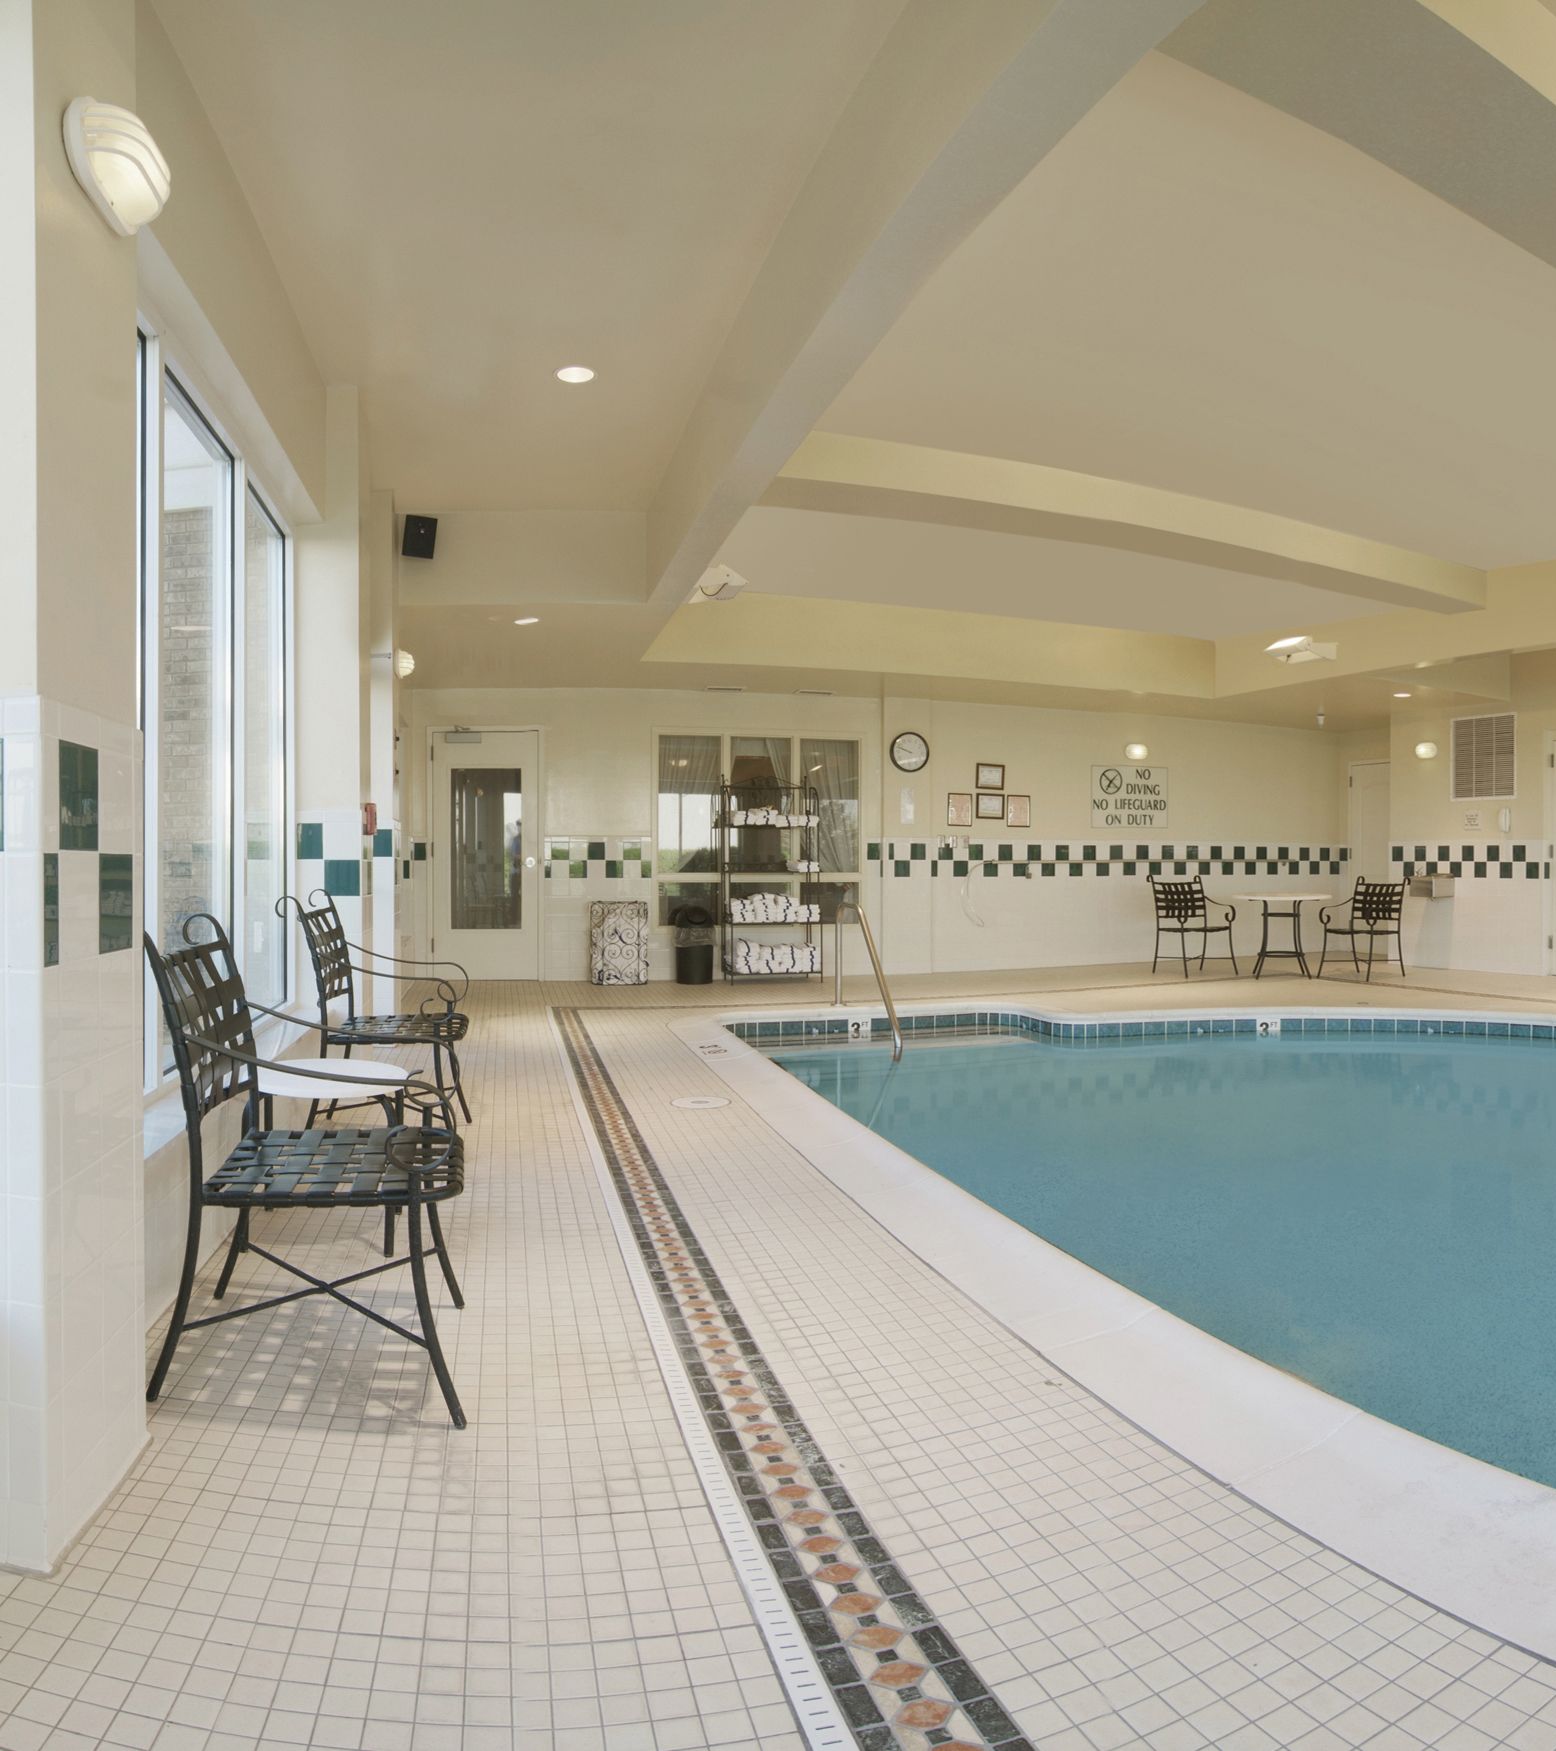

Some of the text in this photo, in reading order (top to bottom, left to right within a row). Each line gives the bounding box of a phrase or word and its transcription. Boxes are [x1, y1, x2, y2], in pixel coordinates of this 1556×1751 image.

[1135, 768, 1151, 780] NO
[1125, 783, 1160, 796] DIVING
[1092, 798, 1167, 811] NO LIFEGUARD
[1105, 813, 1154, 826] ON DUTY
